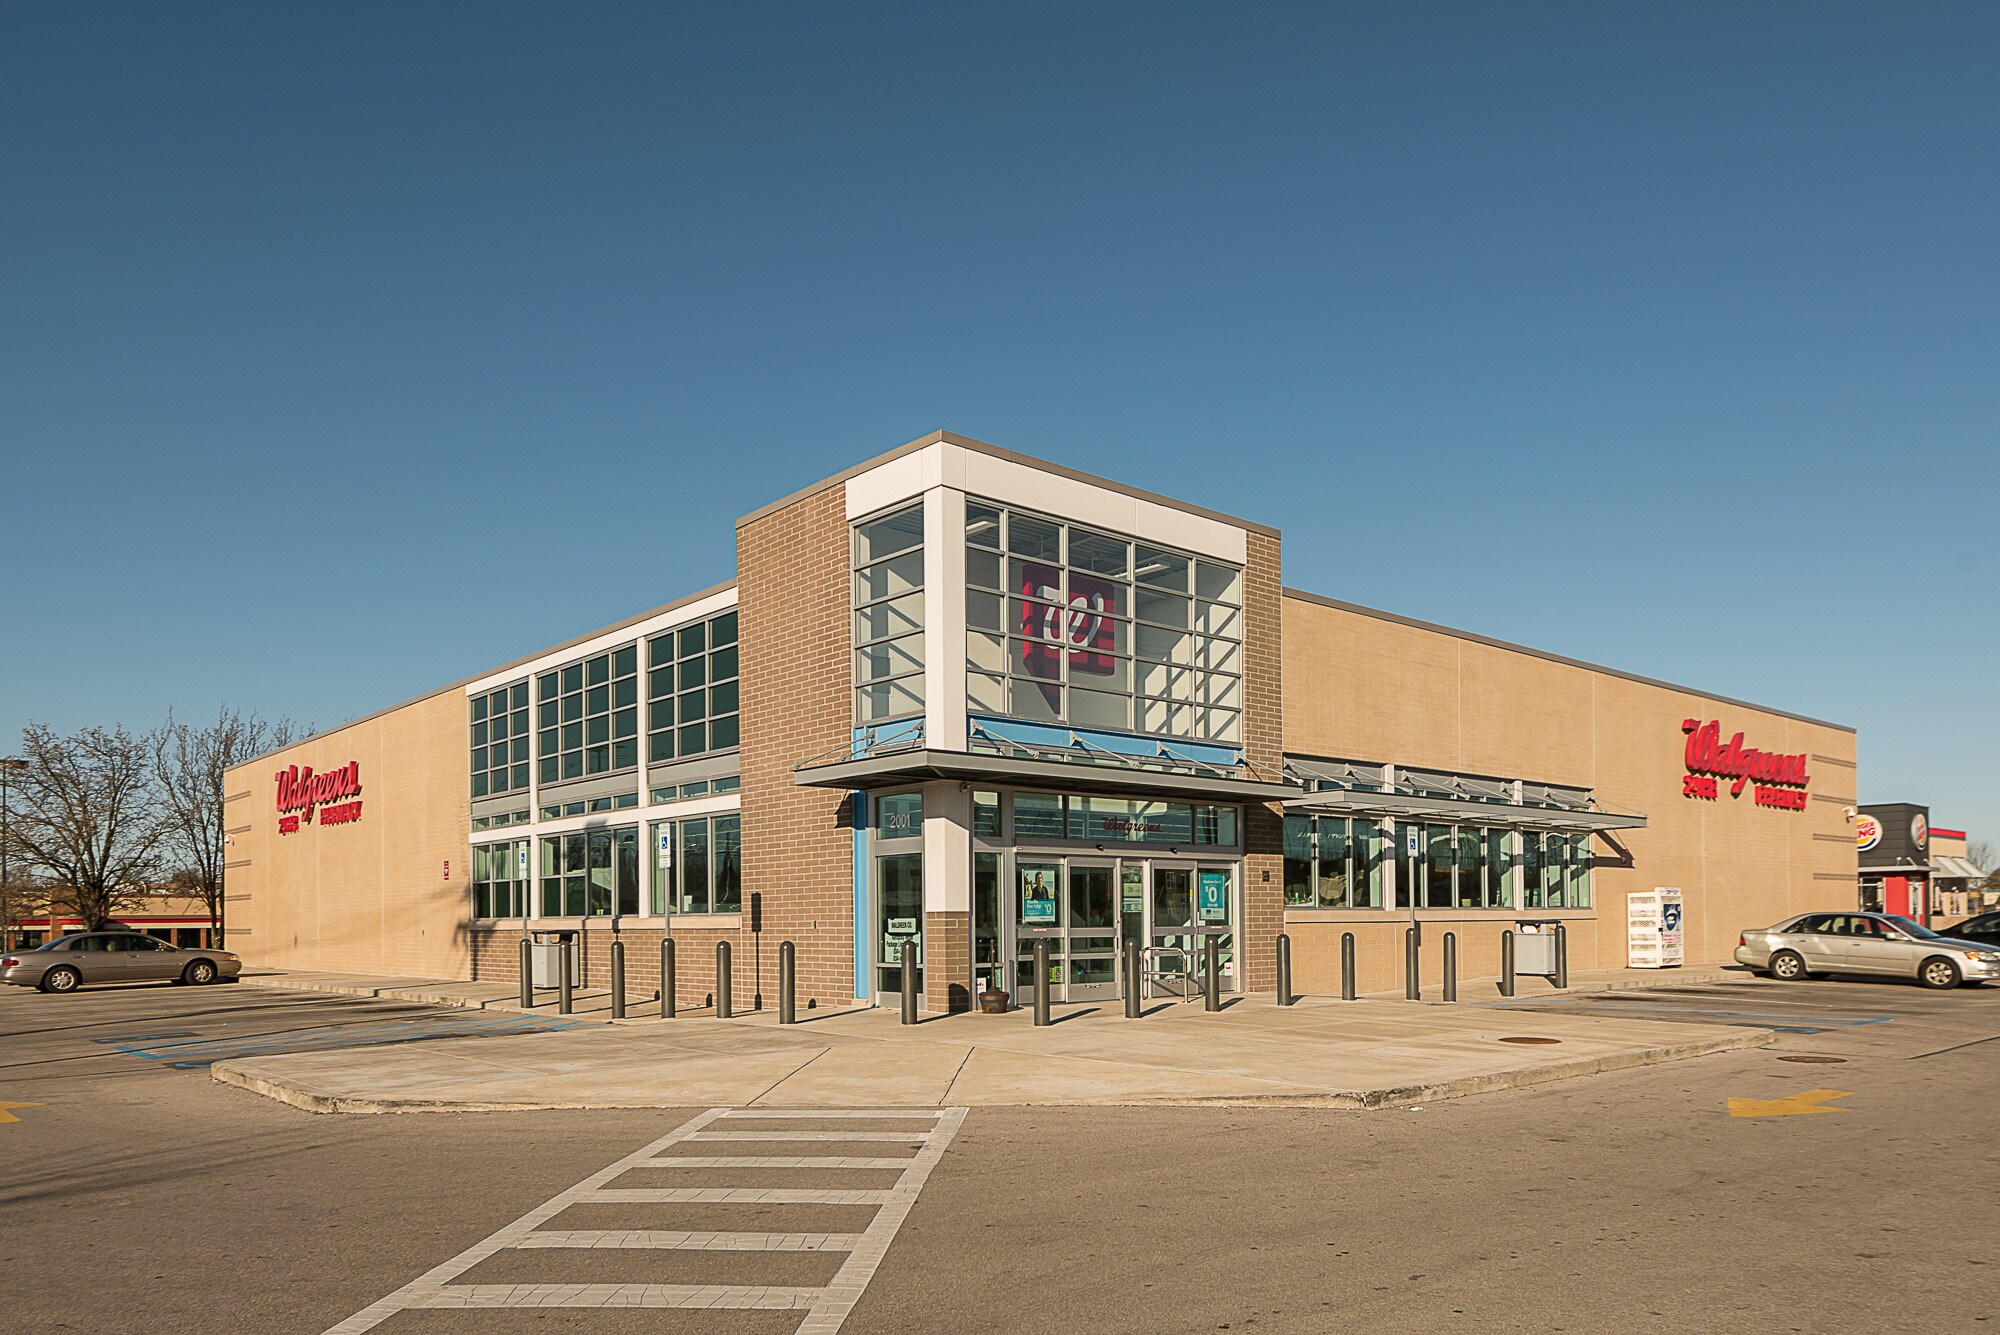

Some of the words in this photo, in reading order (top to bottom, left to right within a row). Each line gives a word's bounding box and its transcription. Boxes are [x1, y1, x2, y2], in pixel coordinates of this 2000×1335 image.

[1682, 718, 1810, 799] Walgreens
[275, 761, 362, 823] Walgreens
[890, 814, 911, 829] 2001
[1102, 816, 1162, 836] Walgreens
